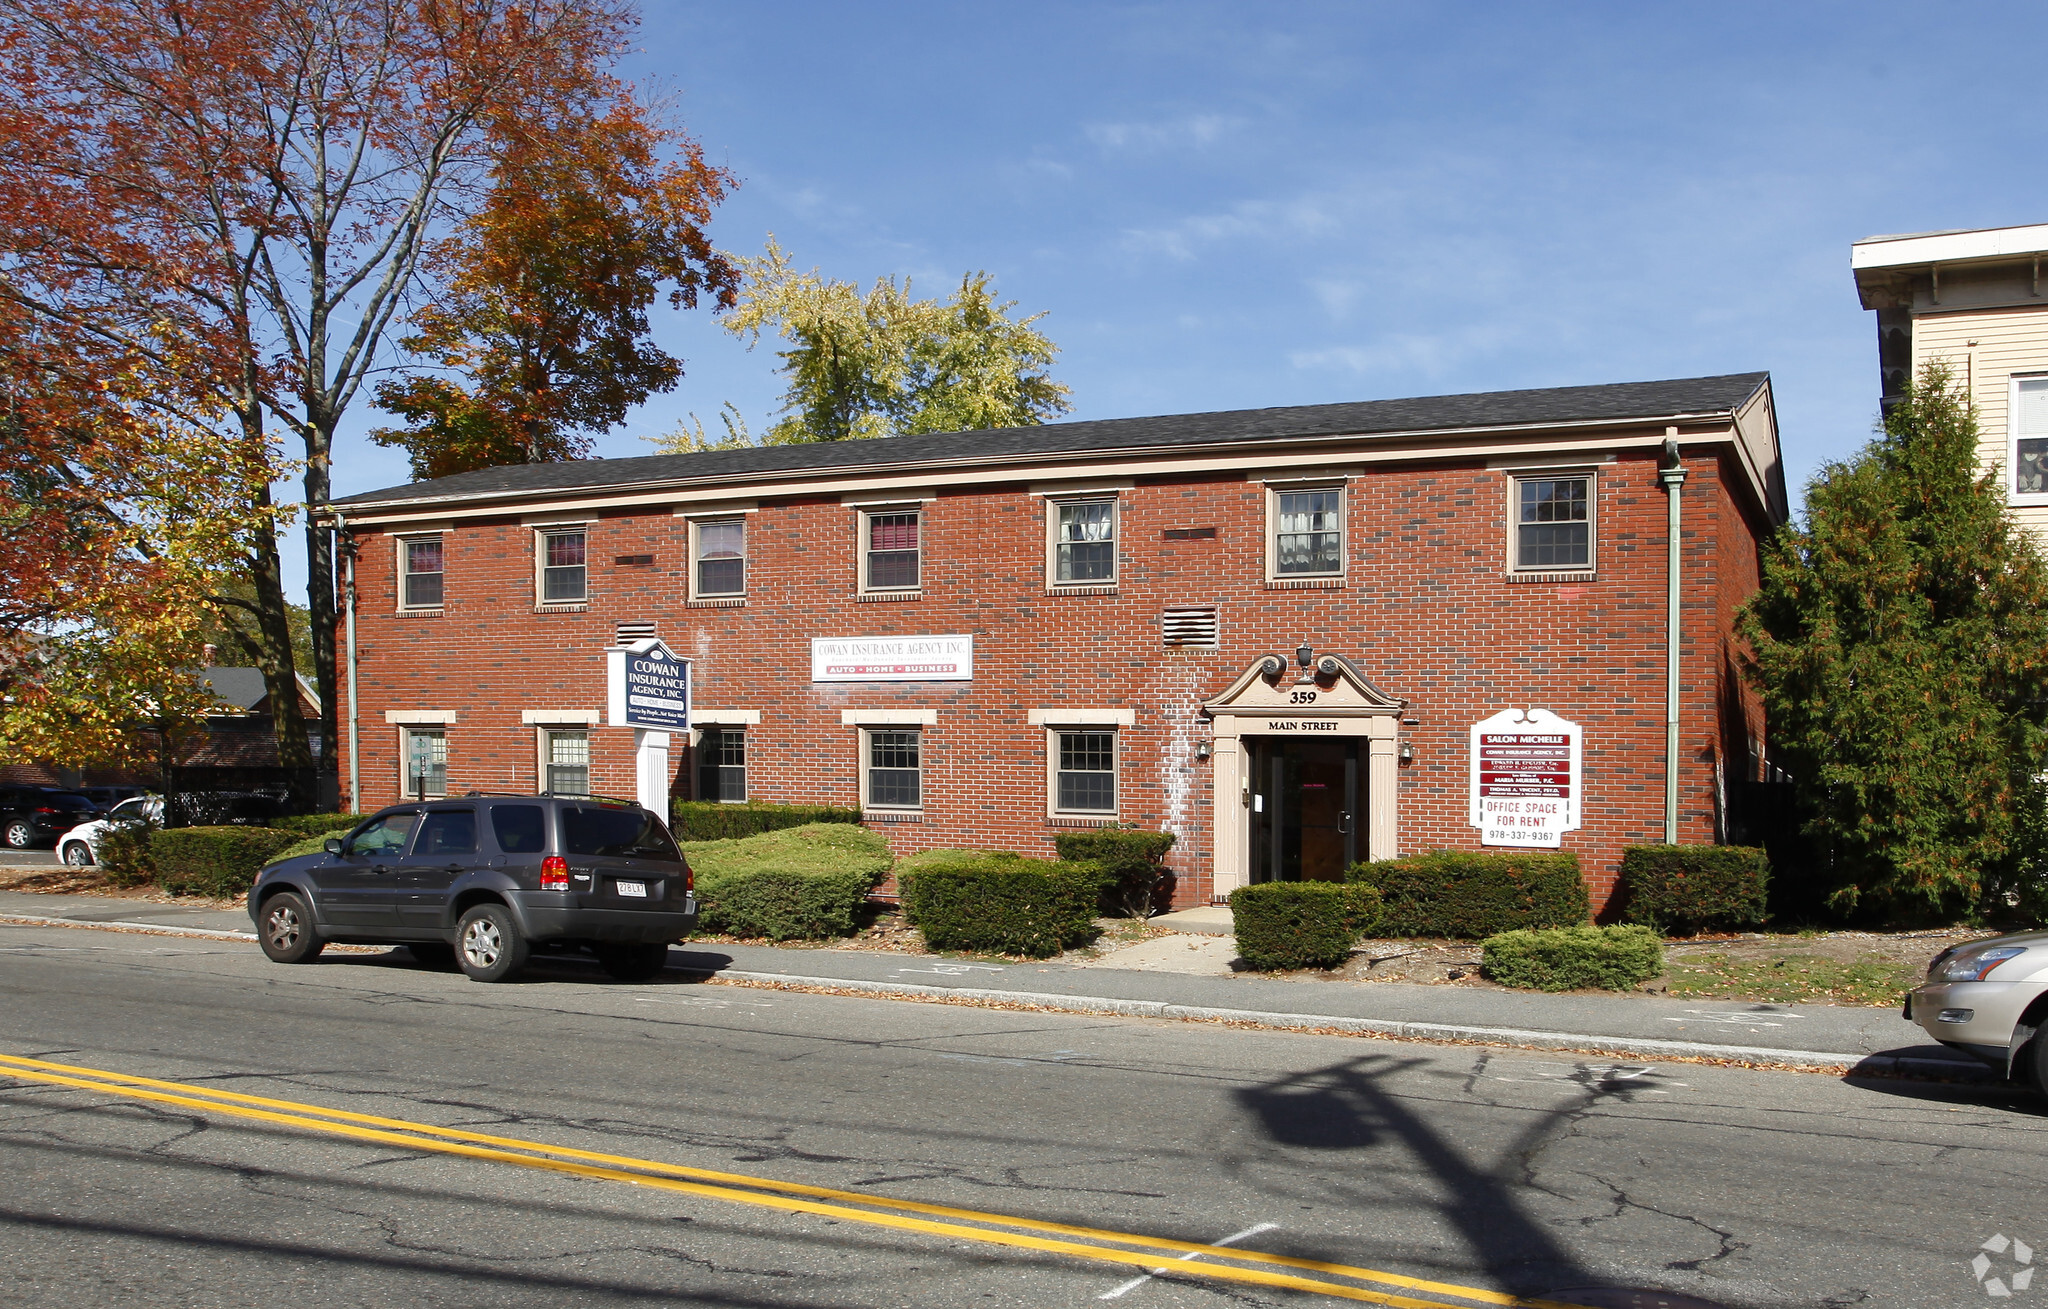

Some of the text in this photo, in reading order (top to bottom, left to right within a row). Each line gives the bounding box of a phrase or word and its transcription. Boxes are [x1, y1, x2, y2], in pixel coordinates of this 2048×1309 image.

[819, 641, 966, 656] COWAN INSURANCE AGENCY INC.
[634, 660, 679, 677] COWAN
[904, 664, 954, 673] BUSINESS
[628, 673, 685, 689] INSURANCE
[632, 685, 683, 699] AGENCY, INC.
[1290, 691, 1317, 704] 359
[1269, 722, 1338, 730] MAIN STREET
[1519, 736, 1563, 744] MICHELLE
[1487, 801, 1557, 814] OFFICE SPACE
[1497, 815, 1546, 827] FOR RENT
[1489, 830, 1554, 841] 978-337-9367
